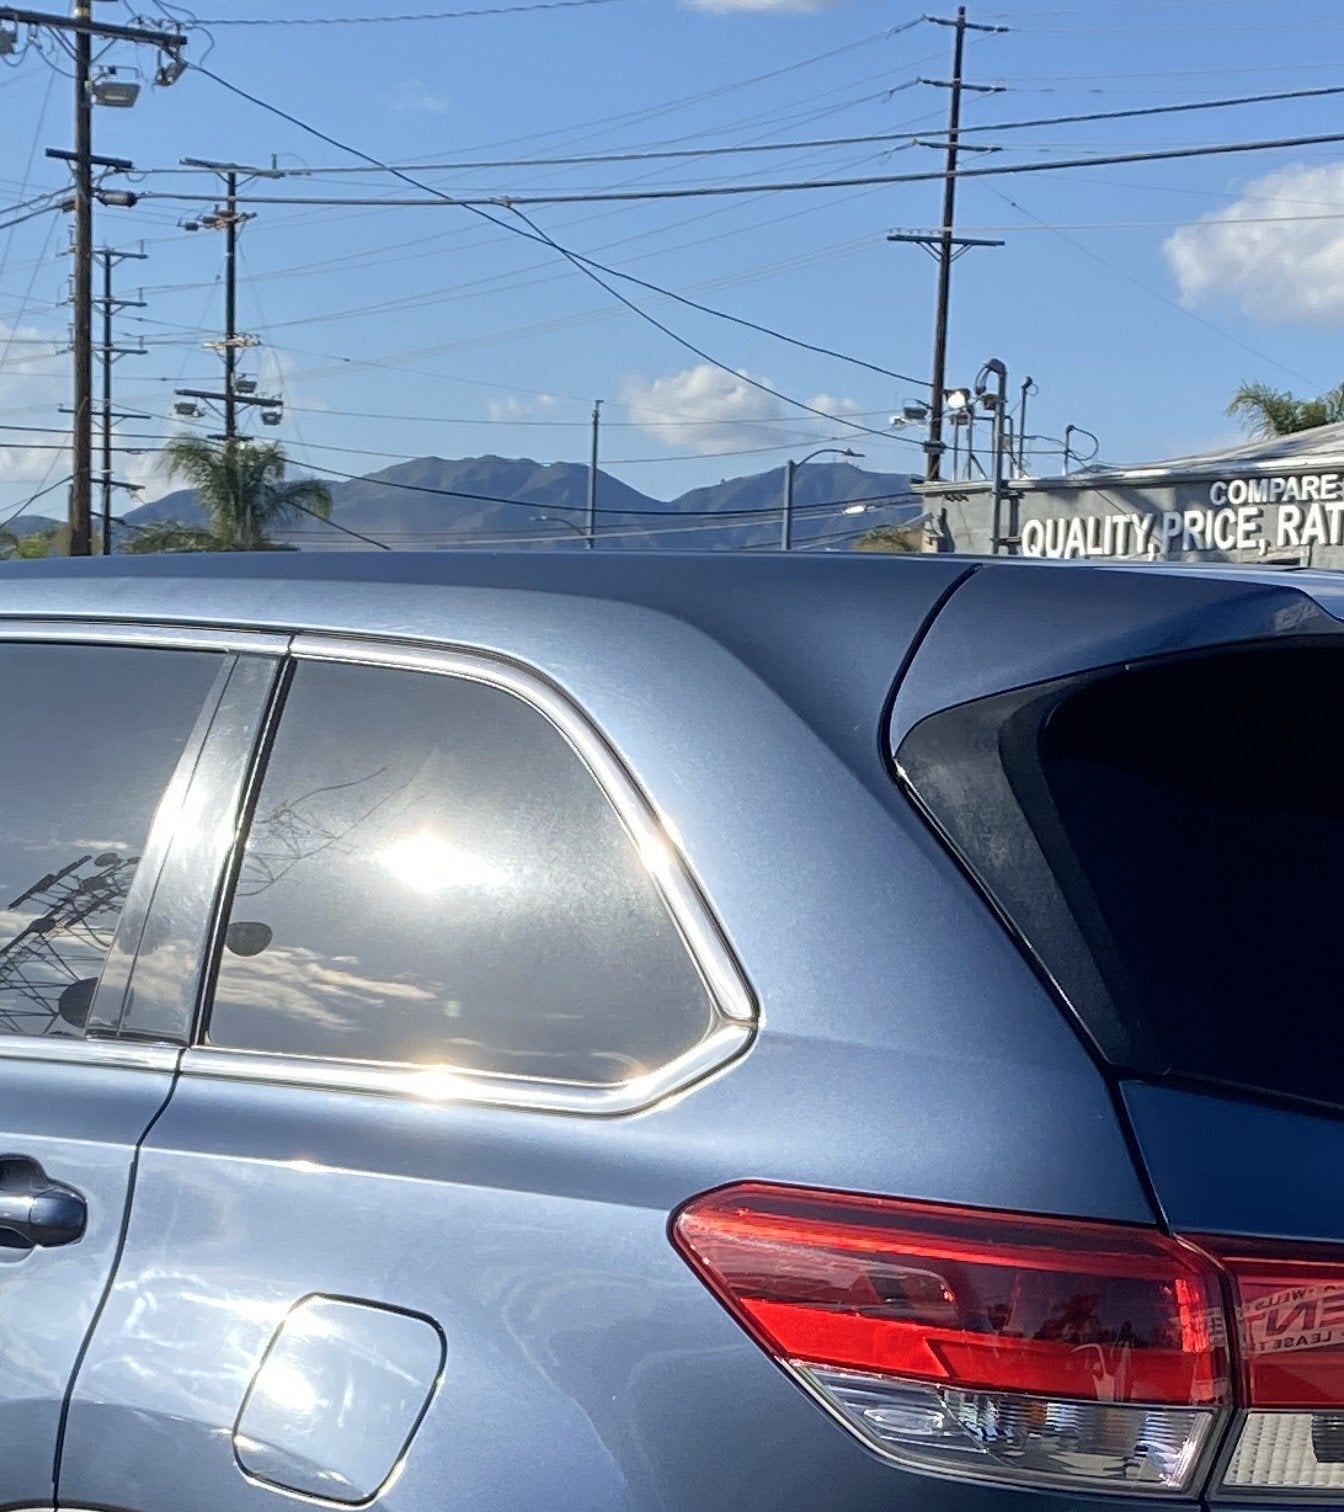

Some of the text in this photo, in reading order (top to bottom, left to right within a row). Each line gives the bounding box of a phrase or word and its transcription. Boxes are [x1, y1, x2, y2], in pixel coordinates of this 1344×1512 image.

[1210, 474, 1339, 506] COMPARE
[1021, 512, 1156, 561] QUALITY,
[1162, 505, 1267, 557] PRICE,
